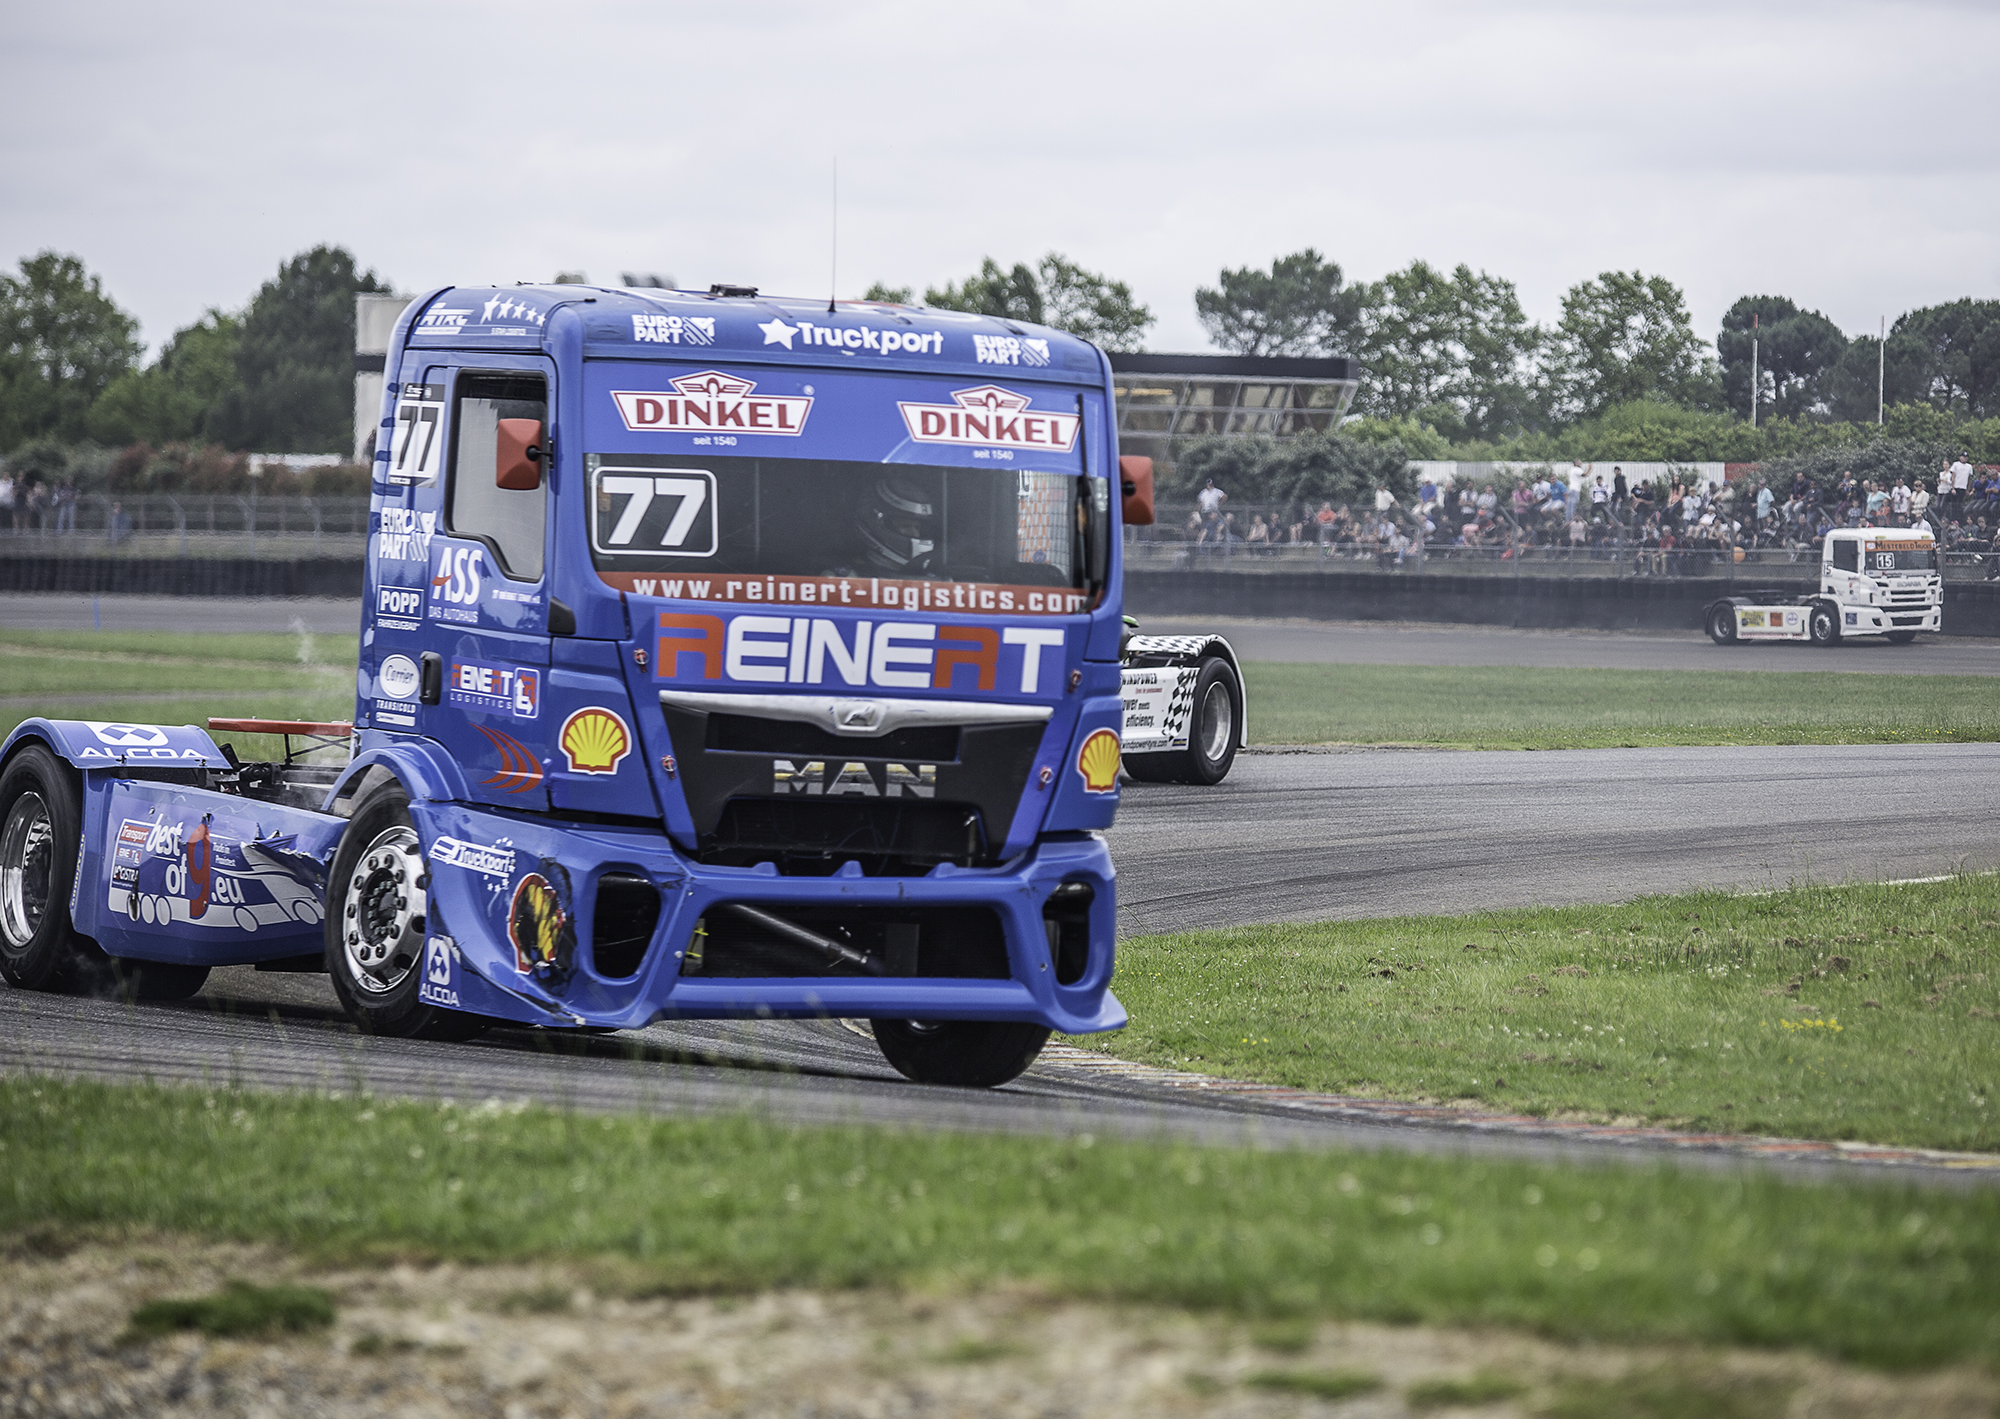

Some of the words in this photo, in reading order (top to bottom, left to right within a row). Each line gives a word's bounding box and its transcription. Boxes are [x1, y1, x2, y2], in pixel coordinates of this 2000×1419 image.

[632, 314, 683, 328] EURO
[634, 327, 683, 343] PART
[796, 322, 944, 355] Truckport
[973, 334, 1019, 349] EURO
[976, 349, 1021, 365] PART
[636, 398, 795, 429] DINKEL
[398, 405, 439, 472] 77
[921, 410, 1067, 445] DINKEL
[714, 436, 737, 446] 1540
[381, 507, 415, 534] EURO
[602, 476, 706, 546] 77
[379, 534, 411, 560] PART
[1879, 555, 1892, 567] 15
[432, 547, 482, 605] ASS
[380, 590, 419, 614] POPP
[632, 576, 1088, 614] www.reinert-logistics.com
[656, 612, 1065, 694] REINERT
[386, 664, 414, 684] Carrier
[450, 693, 513, 710] LOGISTICS
[79, 747, 210, 760] ALCOA
[773, 760, 937, 798] MAN
[145, 813, 184, 857] best
[459, 847, 510, 872] Truckport
[166, 853, 187, 896] of
[419, 983, 460, 1007] ALCOA
